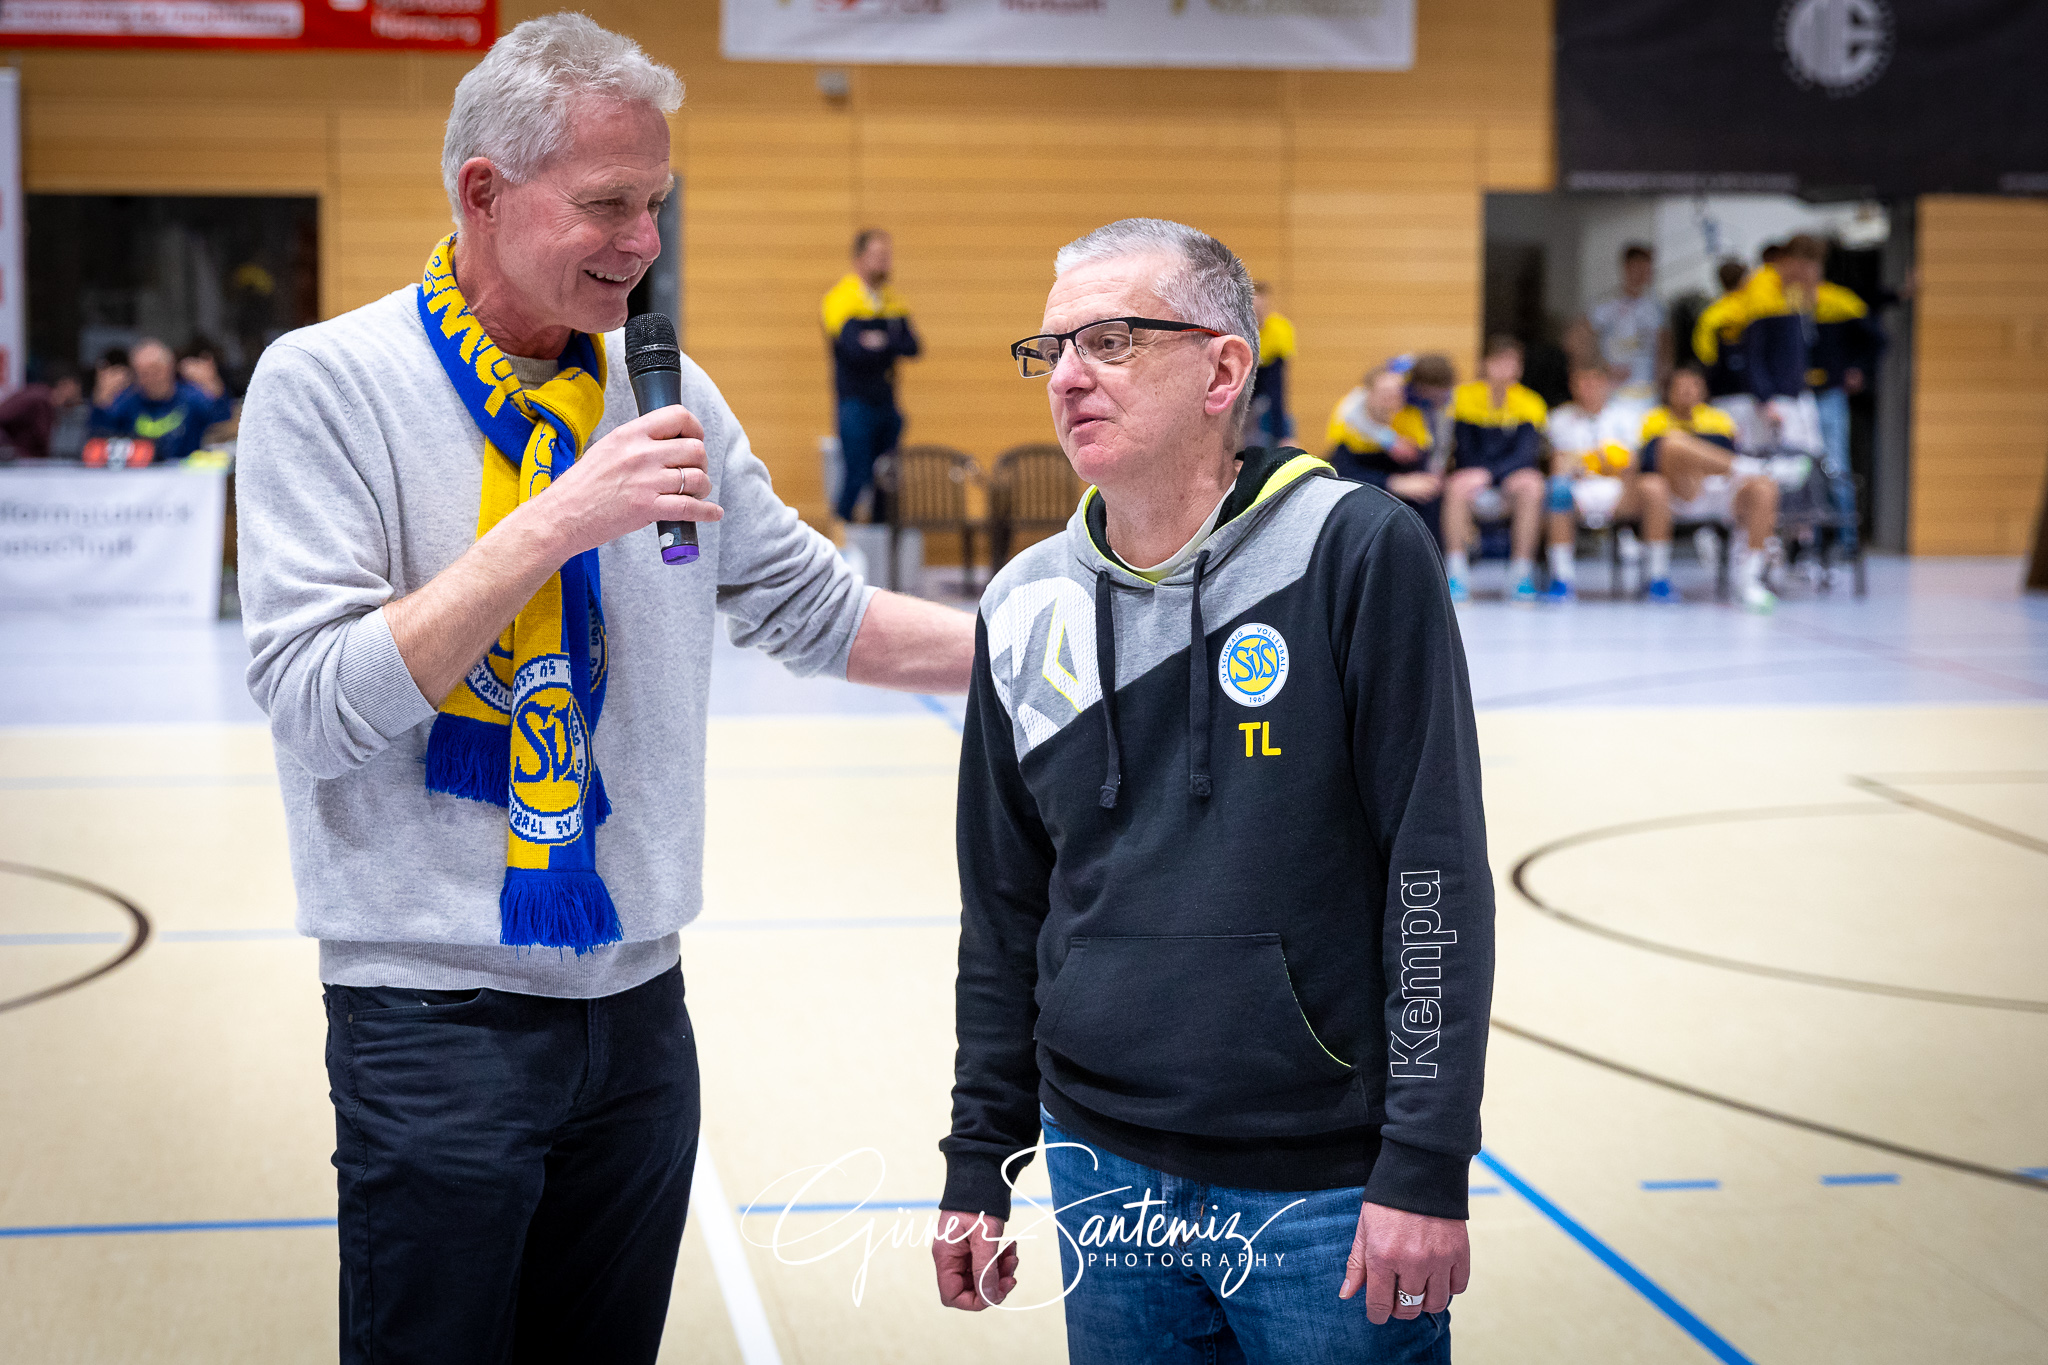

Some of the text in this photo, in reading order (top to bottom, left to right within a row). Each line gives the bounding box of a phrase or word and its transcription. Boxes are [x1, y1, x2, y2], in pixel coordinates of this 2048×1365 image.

[1221, 631, 1244, 669] SCHWAIG
[1256, 627, 1286, 673] VOLLEYBALL
[1249, 694, 1267, 704] 1967
[1238, 721, 1282, 757] TL
[1390, 870, 1457, 1079] Kempa
